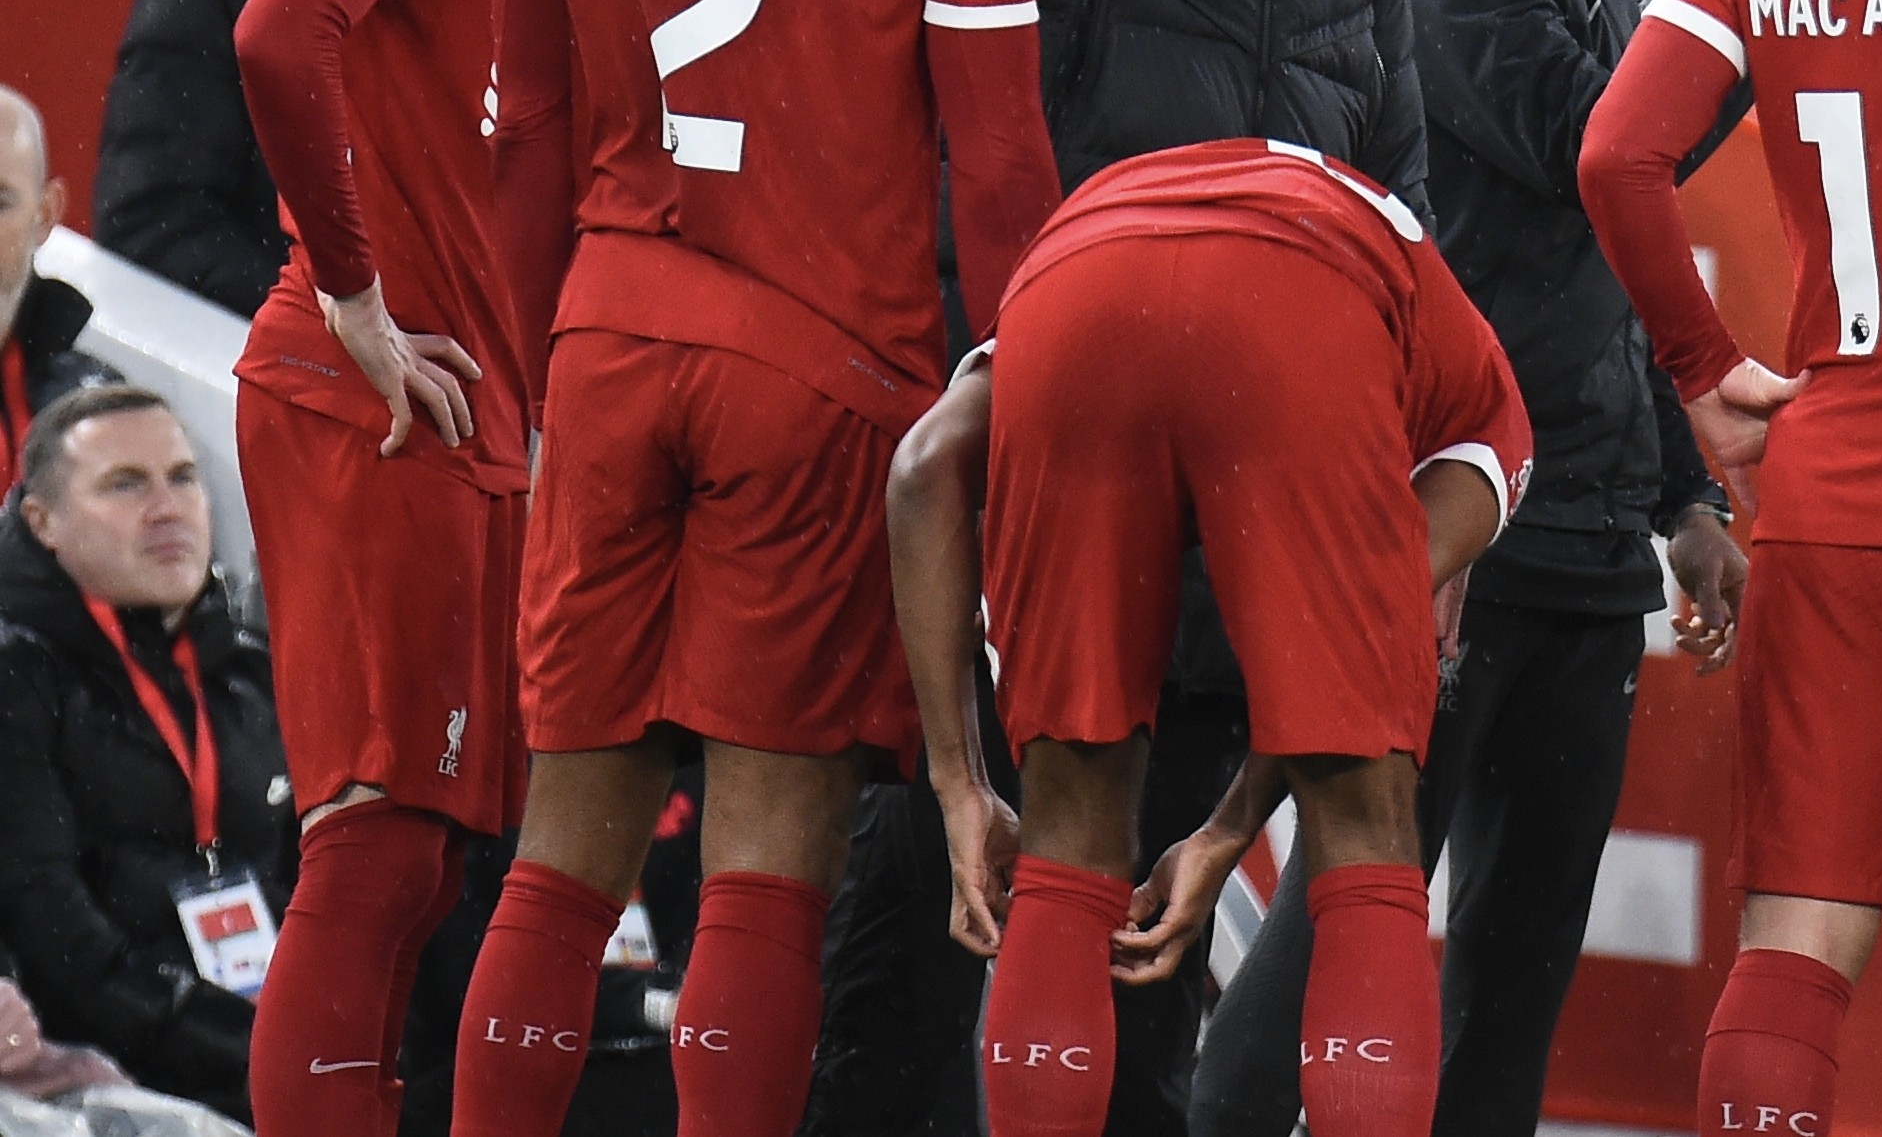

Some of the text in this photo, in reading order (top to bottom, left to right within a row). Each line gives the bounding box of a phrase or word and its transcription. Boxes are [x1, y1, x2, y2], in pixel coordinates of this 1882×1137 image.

[484, 1017, 579, 1052] LFC
[993, 1042, 1091, 1071] LFC
[1721, 1102, 1819, 1137] LFC
